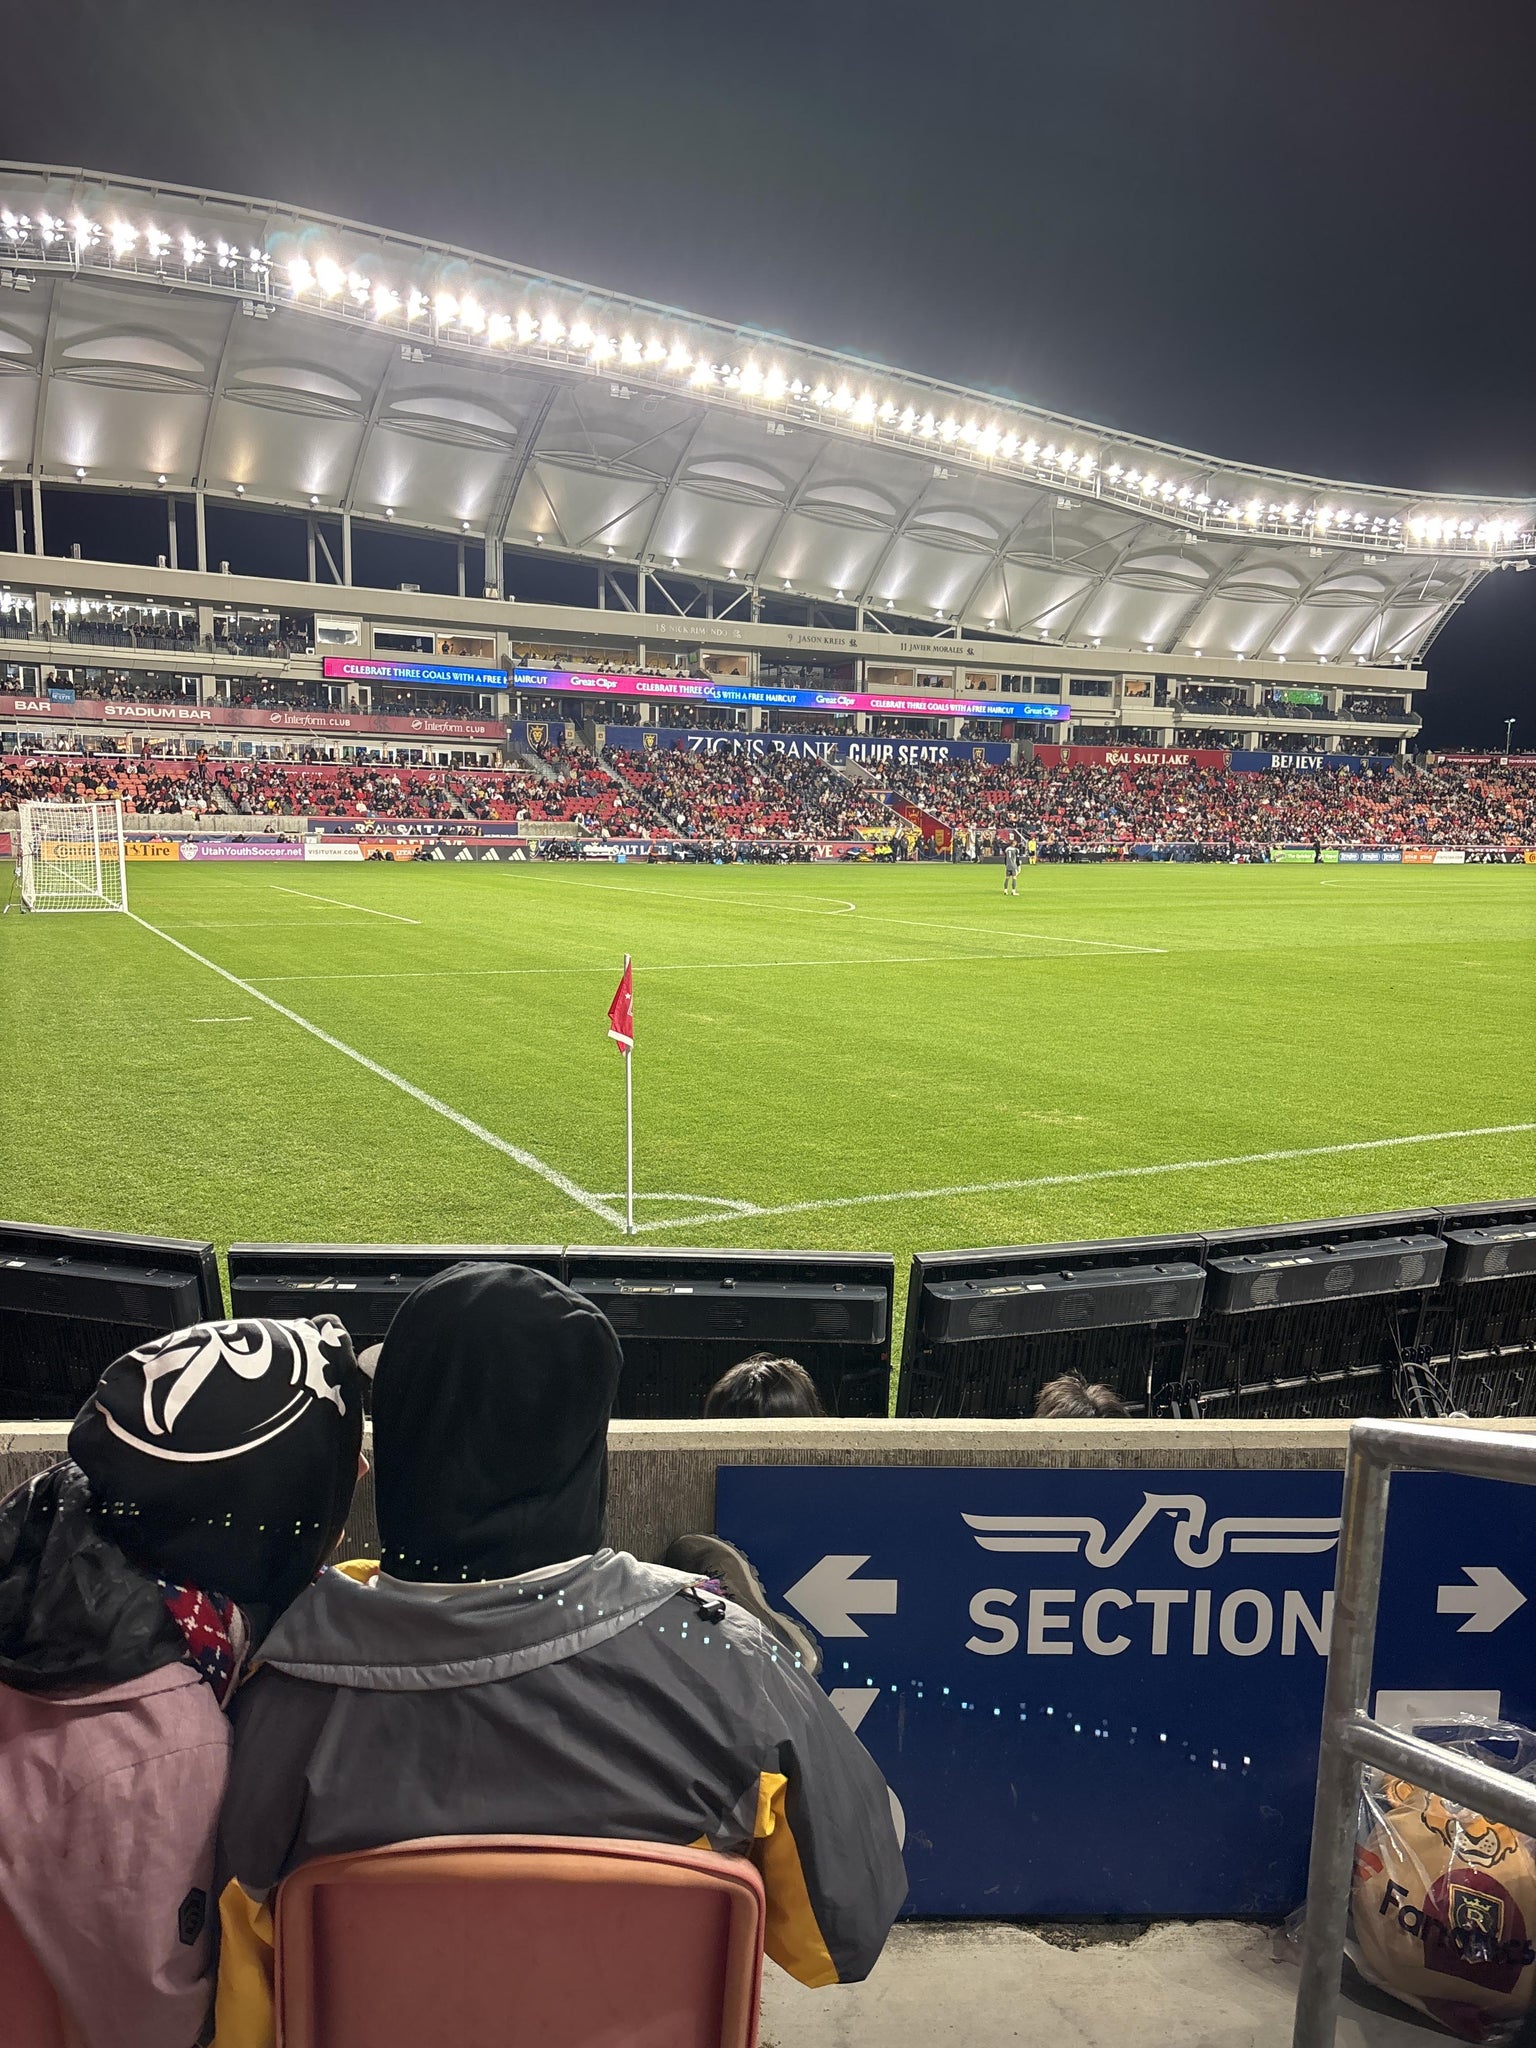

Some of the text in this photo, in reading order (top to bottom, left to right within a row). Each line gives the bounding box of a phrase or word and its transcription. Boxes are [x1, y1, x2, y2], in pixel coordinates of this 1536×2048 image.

[655, 623, 667, 634] 18
[690, 627, 729, 638] RIMNDO
[788, 633, 846, 646] 9 JASON KREIS
[900, 642, 964, 655] 11 JAVIER MORALES
[343, 665, 392, 677] CELEBRATE
[393, 668, 421, 679] THREE
[422, 670, 451, 681] GOALS
[452, 672, 474, 682] WITH
[475, 674, 482, 683] A
[483, 674, 502, 684] FREE
[570, 676, 617, 689] Great Clips
[636, 682, 678, 694] CELEBRATE
[679, 685, 702, 695] THREE
[722, 691, 741, 700] WITH
[742, 692, 748, 700] A
[748, 693, 765, 702] FREE
[766, 693, 797, 703] HAIRCUT
[14, 701, 51, 712] BAR
[815, 695, 856, 707] Great Clips
[870, 699, 905, 709] CELEBRATE
[906, 701, 927, 711] THREE
[928, 702, 949, 712] GOALS
[950, 703, 967, 713] WITH
[972, 704, 986, 713] FREE
[987, 705, 1014, 715] HAIRCUT
[105, 706, 211, 720] STADIUM BAR
[1023, 706, 1059, 718] Great Clips
[284, 713, 351, 728] Interform CLUB
[424, 721, 485, 734] Interform CLUB
[898, 745, 949, 766] SEATS
[1133, 753, 1160, 765] SALT
[1161, 754, 1189, 766] LAKE
[1271, 755, 1324, 769] BELIEVE
[140, 845, 170, 856] Tire
[201, 846, 303, 856] UtahYouthSoccer.net
[964, 1587, 1335, 1656] SECTION
